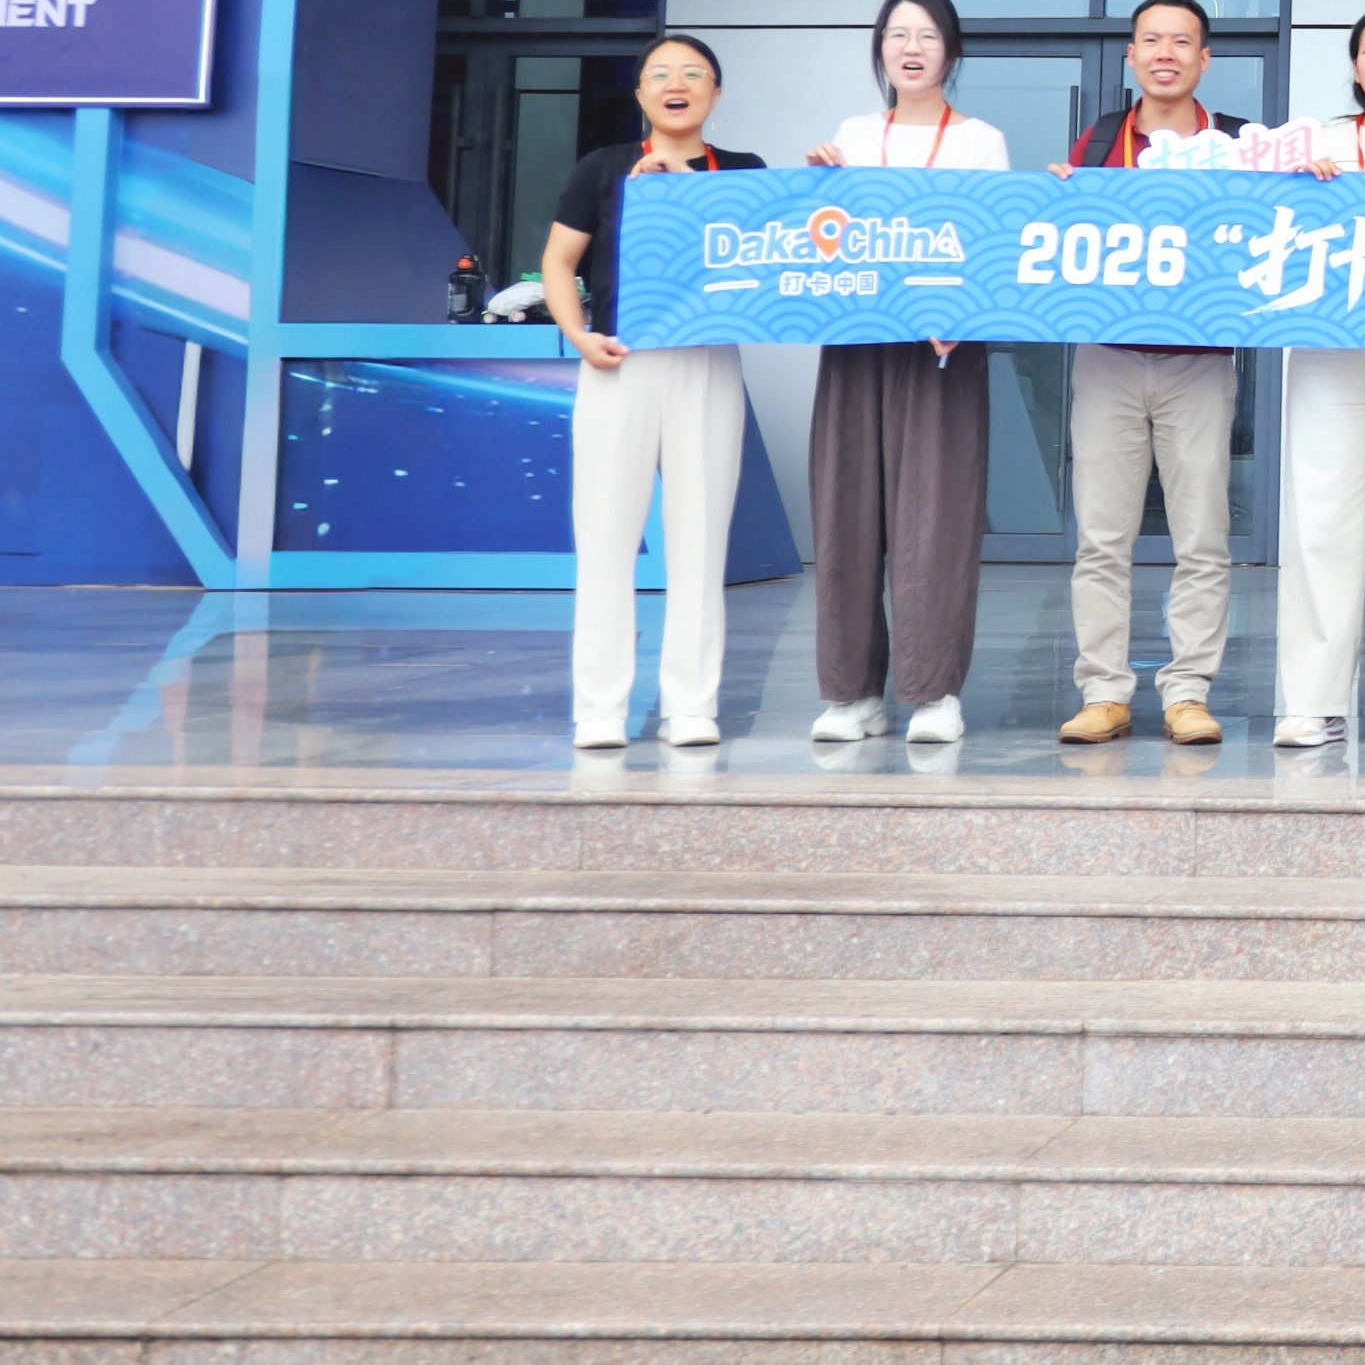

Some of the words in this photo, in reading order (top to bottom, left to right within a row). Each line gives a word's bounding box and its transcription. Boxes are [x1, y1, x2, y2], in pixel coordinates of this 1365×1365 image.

[1016, 221, 1188, 287] 2026
[778, 269, 879, 297] 打卡中国
